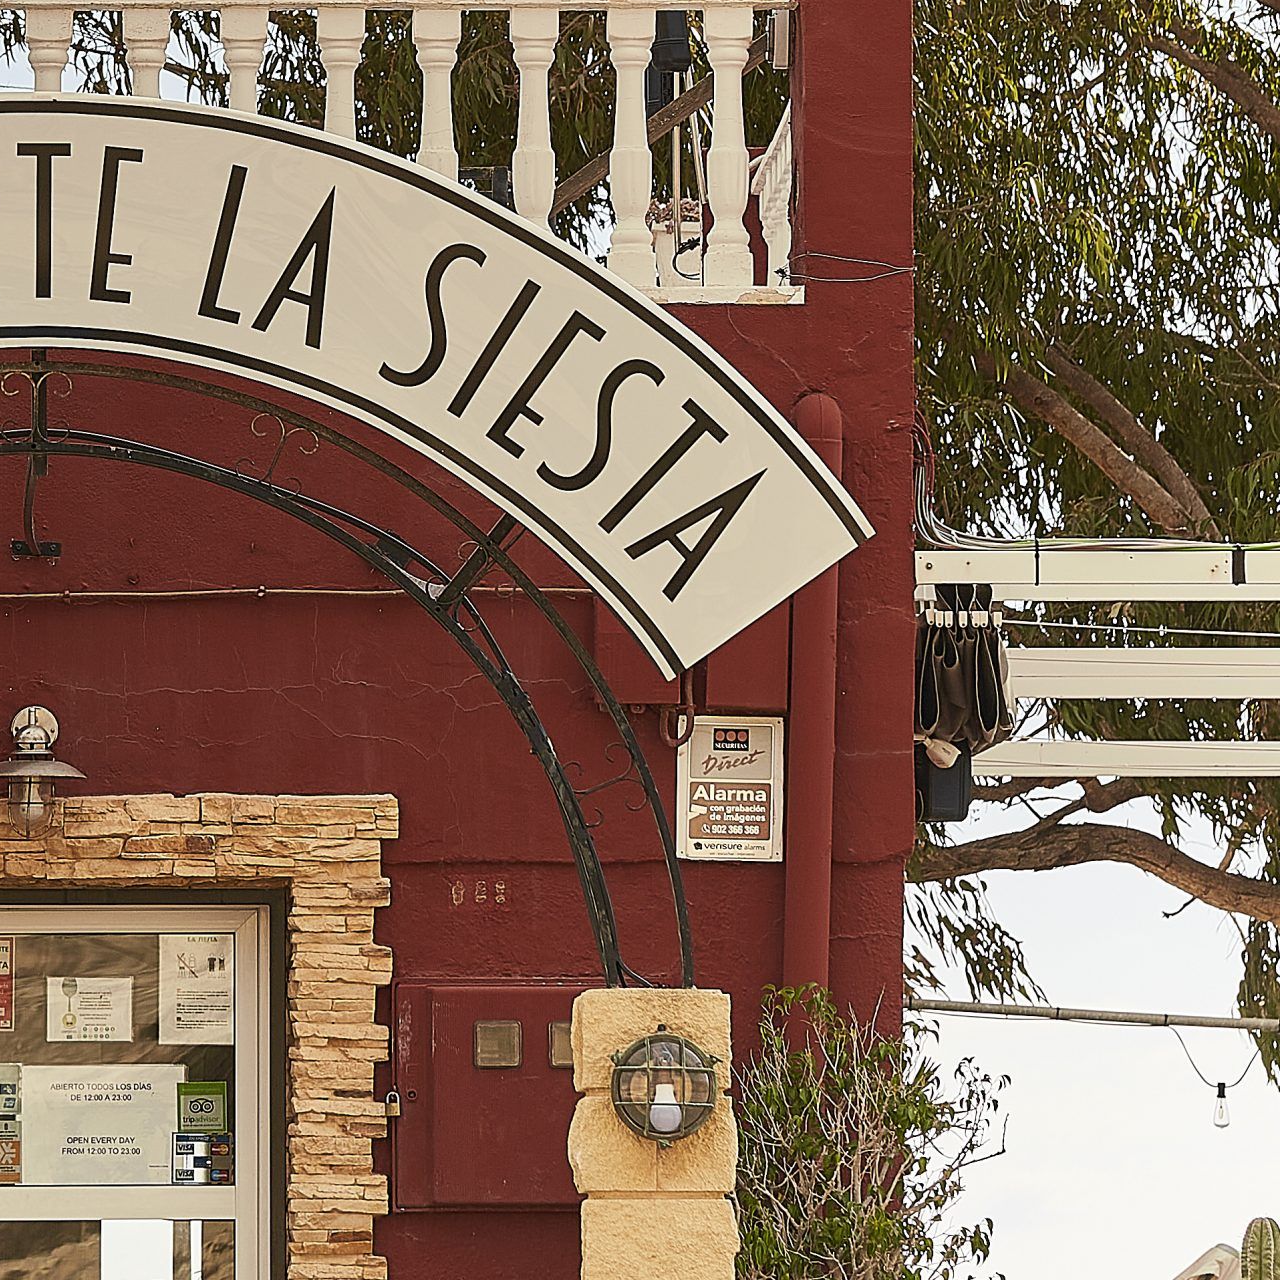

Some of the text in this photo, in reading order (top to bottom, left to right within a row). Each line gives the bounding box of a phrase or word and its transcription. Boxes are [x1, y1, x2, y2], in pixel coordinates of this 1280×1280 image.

[197, 164, 337, 351] LA
[377, 241, 770, 604] SIESTA
[701, 749, 766, 775] Direct
[692, 784, 767, 802] Alarma
[725, 803, 766, 814] grabación
[709, 813, 721, 821] de
[711, 825, 727, 834] 902
[703, 842, 743, 850] verisure
[133, 1082, 152, 1090] DÍAS
[182, 1115, 219, 1125] tripadvisor
[177, 1143, 194, 1151] VISA
[177, 1170, 194, 1178] VISA
